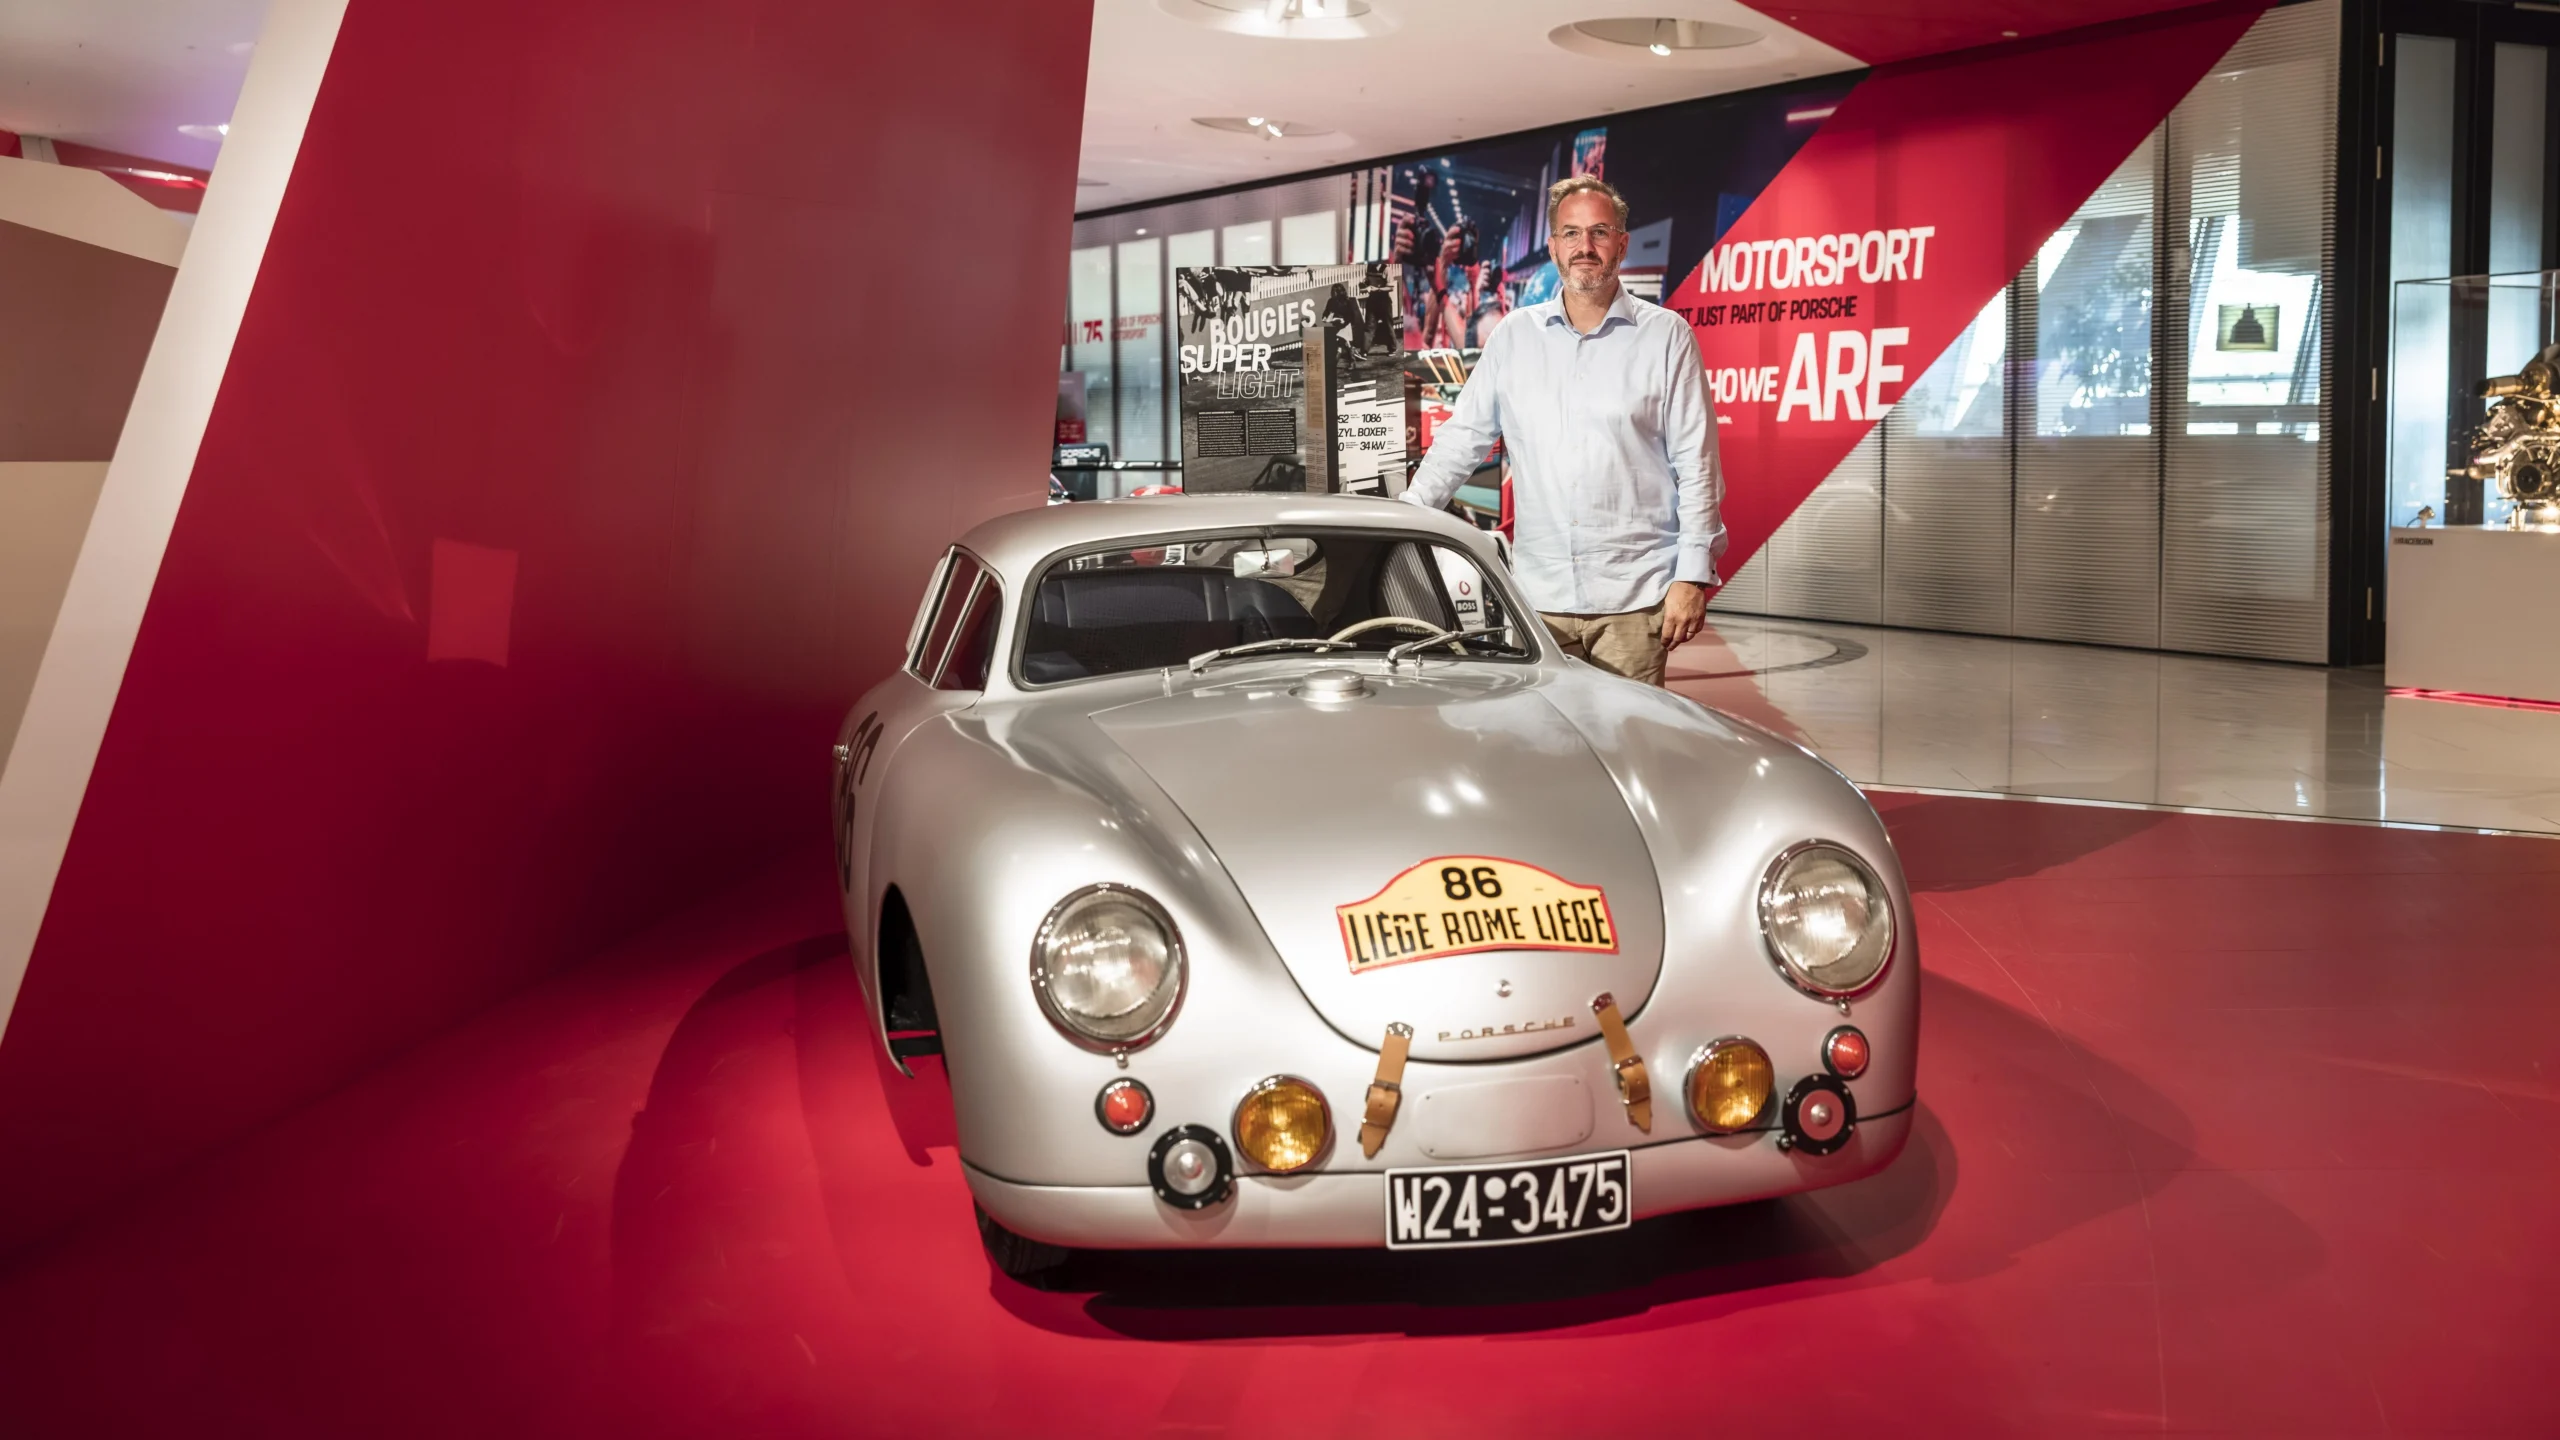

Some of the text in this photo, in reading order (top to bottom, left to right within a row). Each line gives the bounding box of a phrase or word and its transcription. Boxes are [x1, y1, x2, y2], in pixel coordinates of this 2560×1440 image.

[1700, 226, 1935, 293] MOTORSPORT
[1210, 298, 1317, 350] BOUGIES
[1694, 305, 1726, 327] JUST
[1730, 302, 1765, 324] PART
[1768, 300, 1787, 322] OF
[1790, 296, 1858, 320] PORSCHE
[1180, 343, 1272, 374] SUPER
[1217, 369, 1300, 399] LIGHT
[1776, 327, 1909, 422] ARE
[1358, 427, 1387, 437] BOXER
[1362, 413, 1382, 422] 1086
[1360, 441, 1371, 450] 34
[1371, 440, 1386, 450] kW
[1457, 602, 1476, 611] BOSS
[1441, 867, 1502, 900] 86
[1348, 897, 1611, 964] LIÈGE ROME LIÈGE
[1438, 1016, 1576, 1041] PORSCHE
